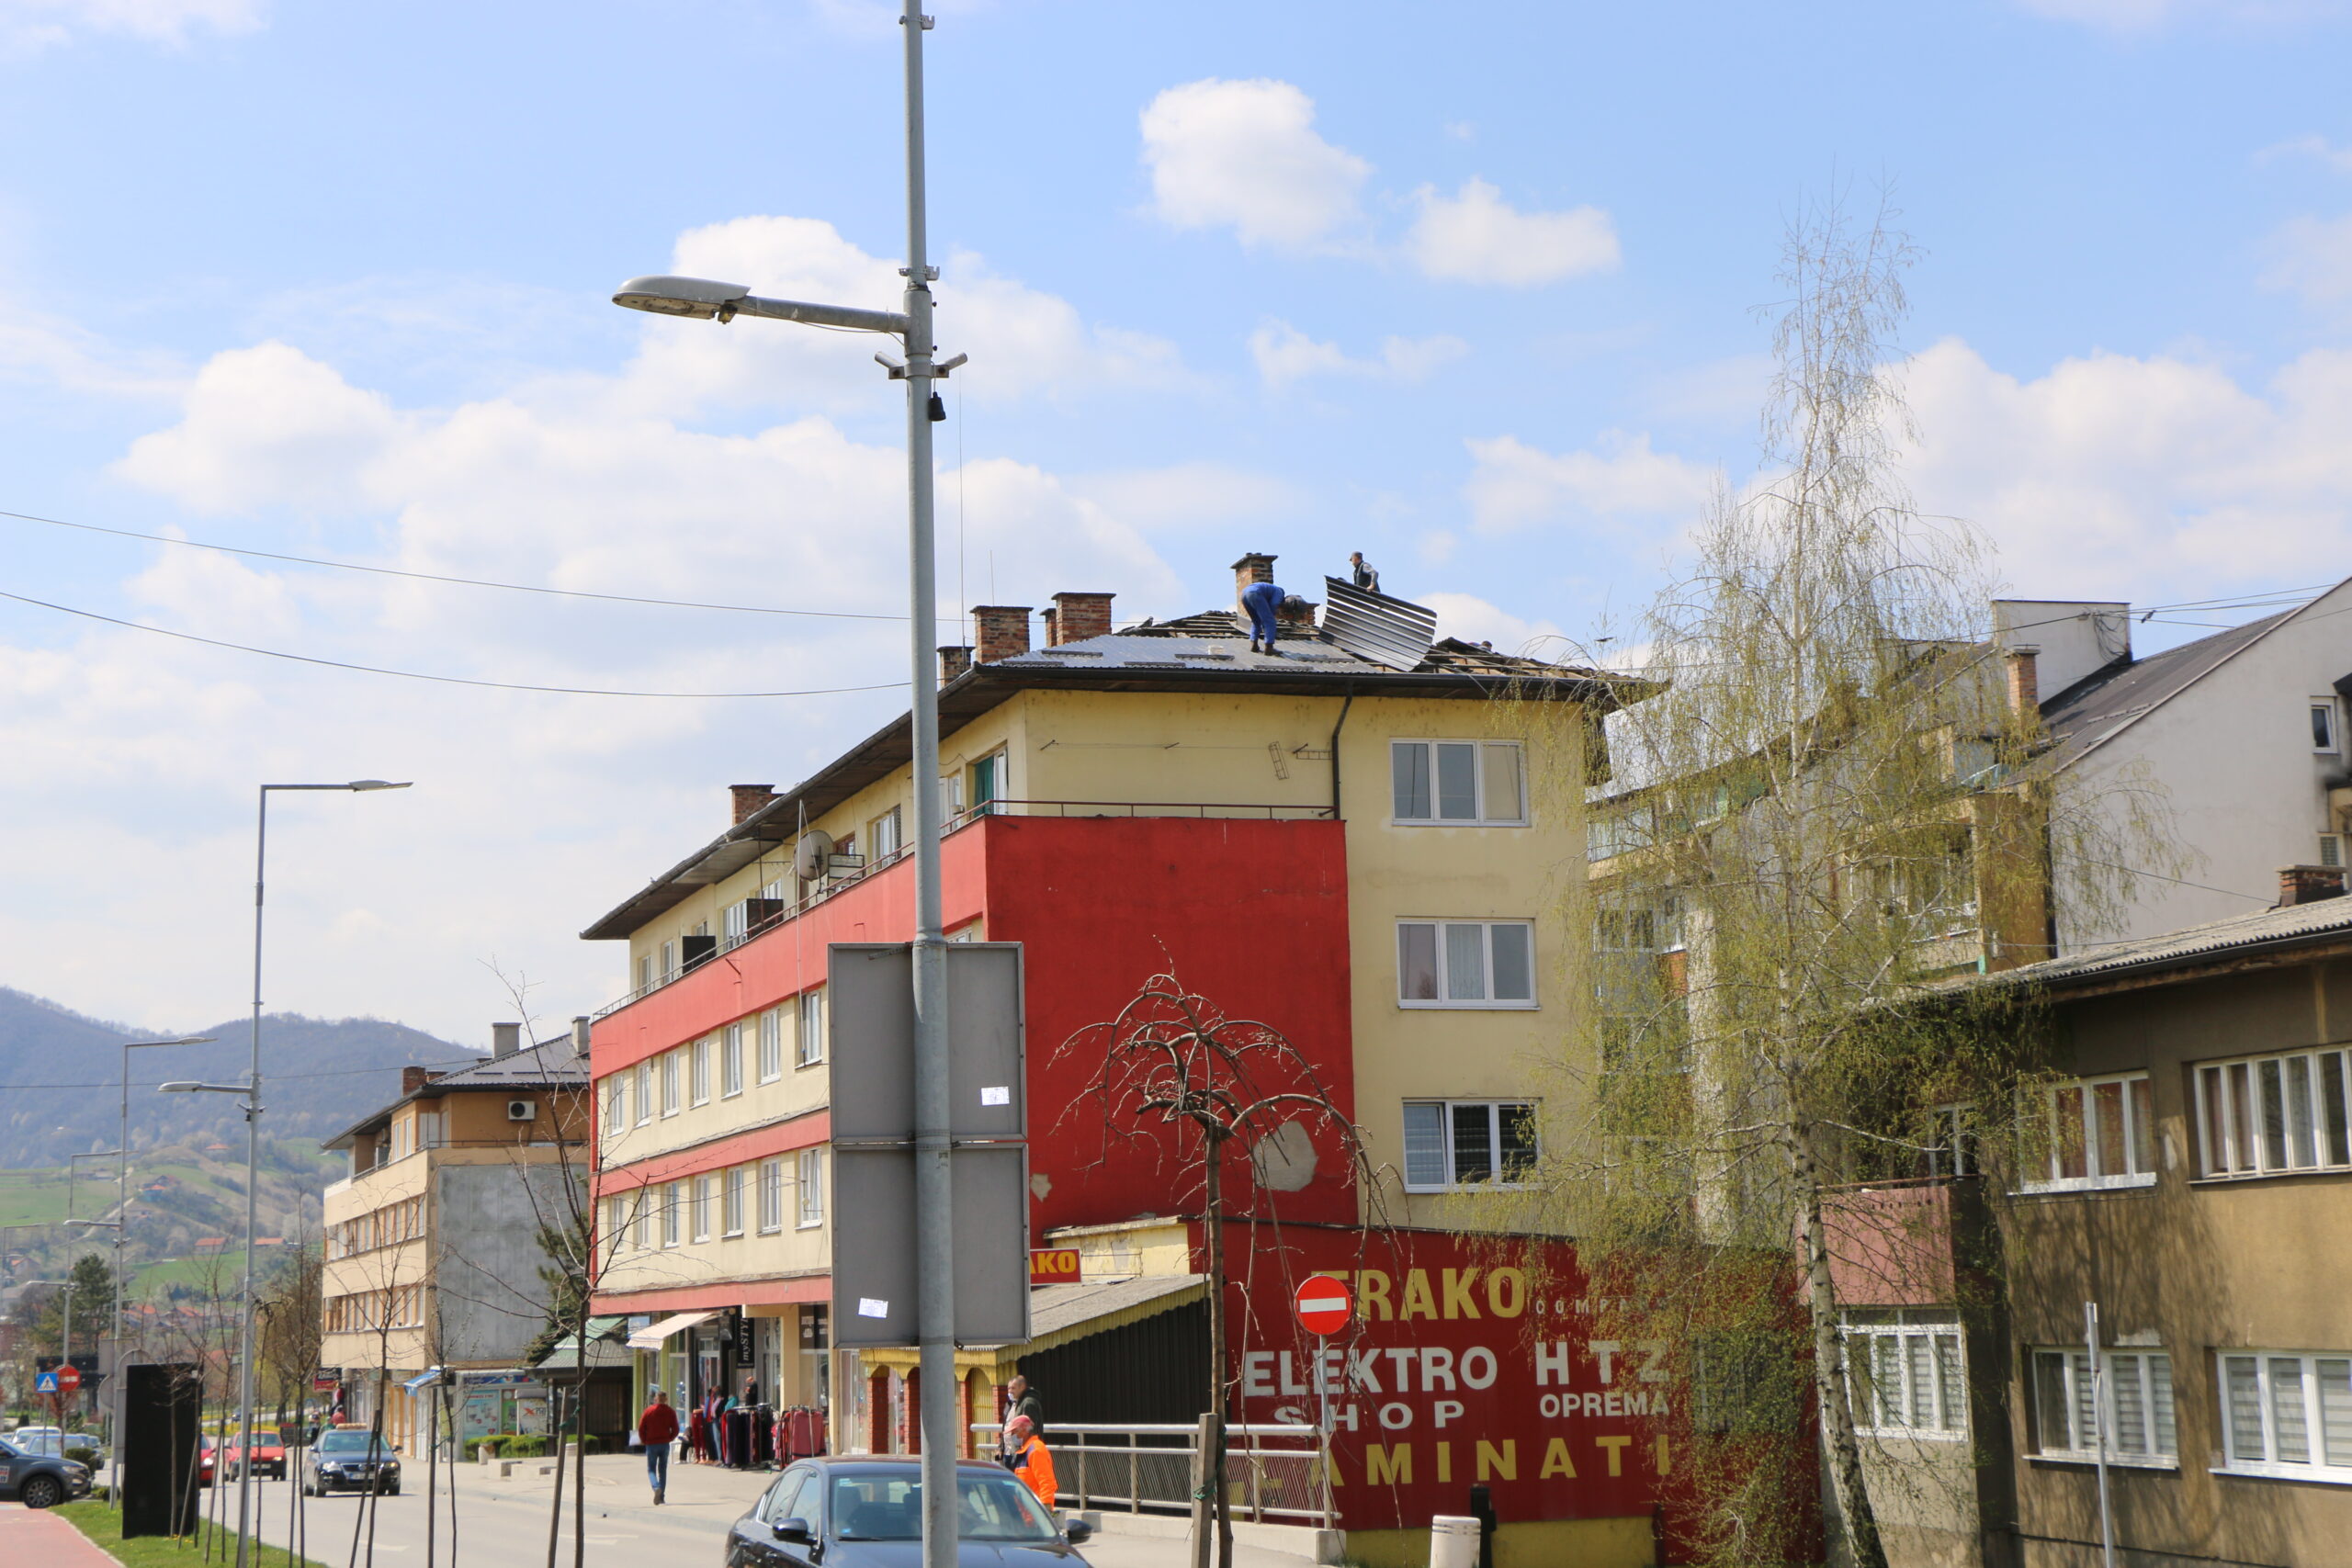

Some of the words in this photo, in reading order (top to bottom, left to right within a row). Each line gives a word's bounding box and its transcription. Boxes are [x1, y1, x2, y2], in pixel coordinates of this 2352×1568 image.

[1244, 1346, 1498, 1397] ELEKTRO
[1273, 1400, 1465, 1432] SHOP
[1540, 1392, 1670, 1418] OPREMA
